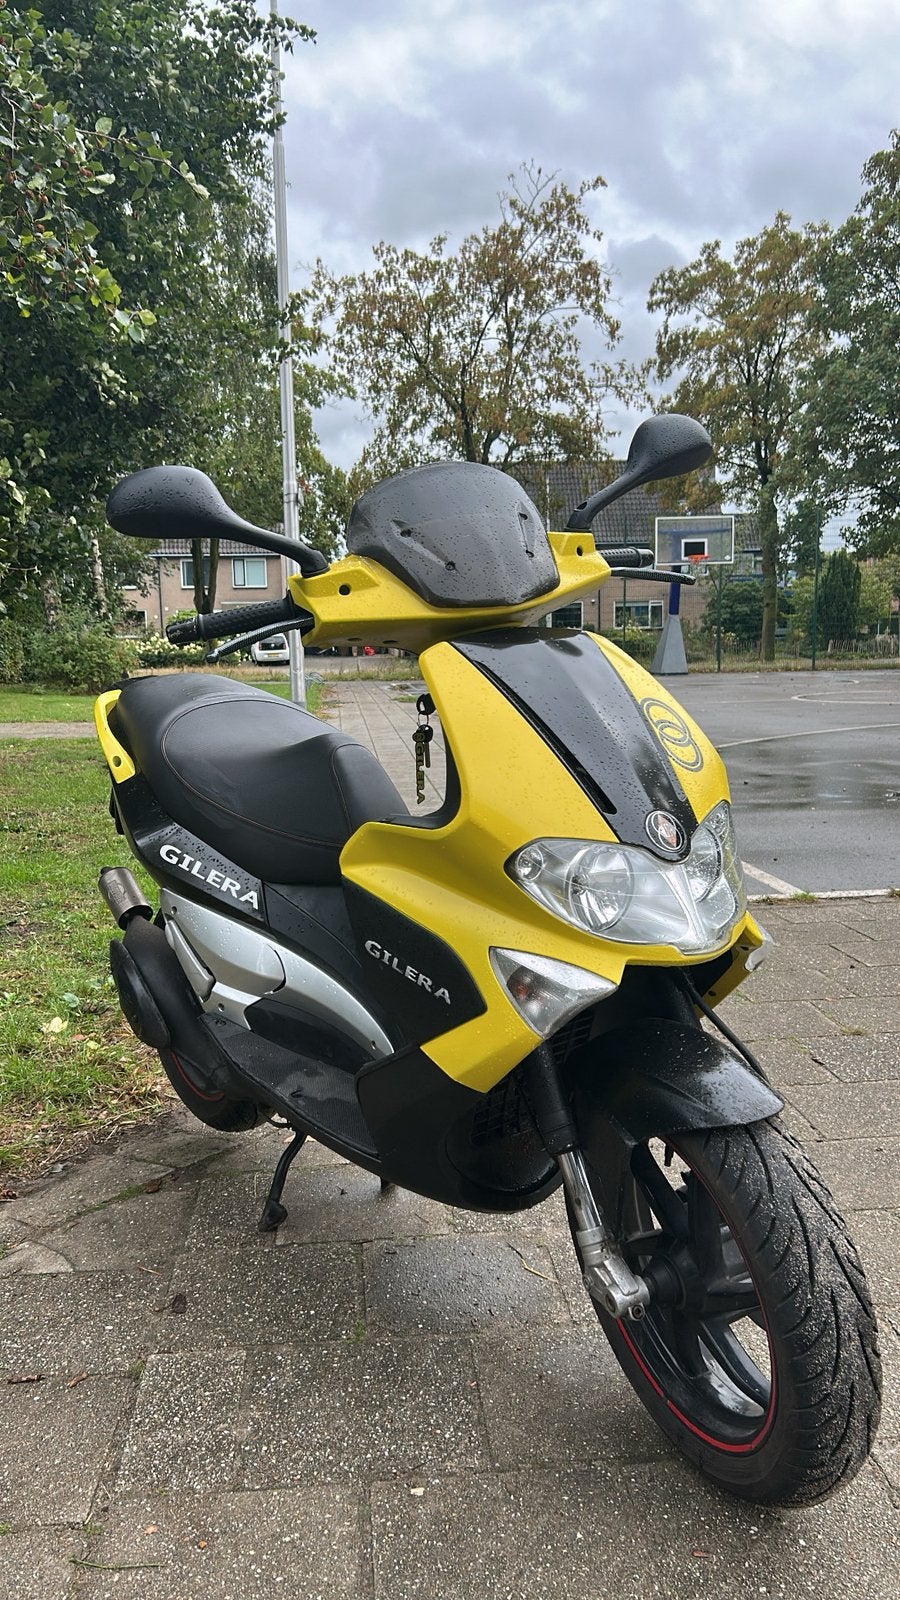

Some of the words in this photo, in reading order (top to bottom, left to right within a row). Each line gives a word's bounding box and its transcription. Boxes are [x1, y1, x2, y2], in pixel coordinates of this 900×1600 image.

[415, 742, 425, 804] GILERA
[160, 844, 259, 910] GILERA
[364, 940, 451, 1005] GILERA
